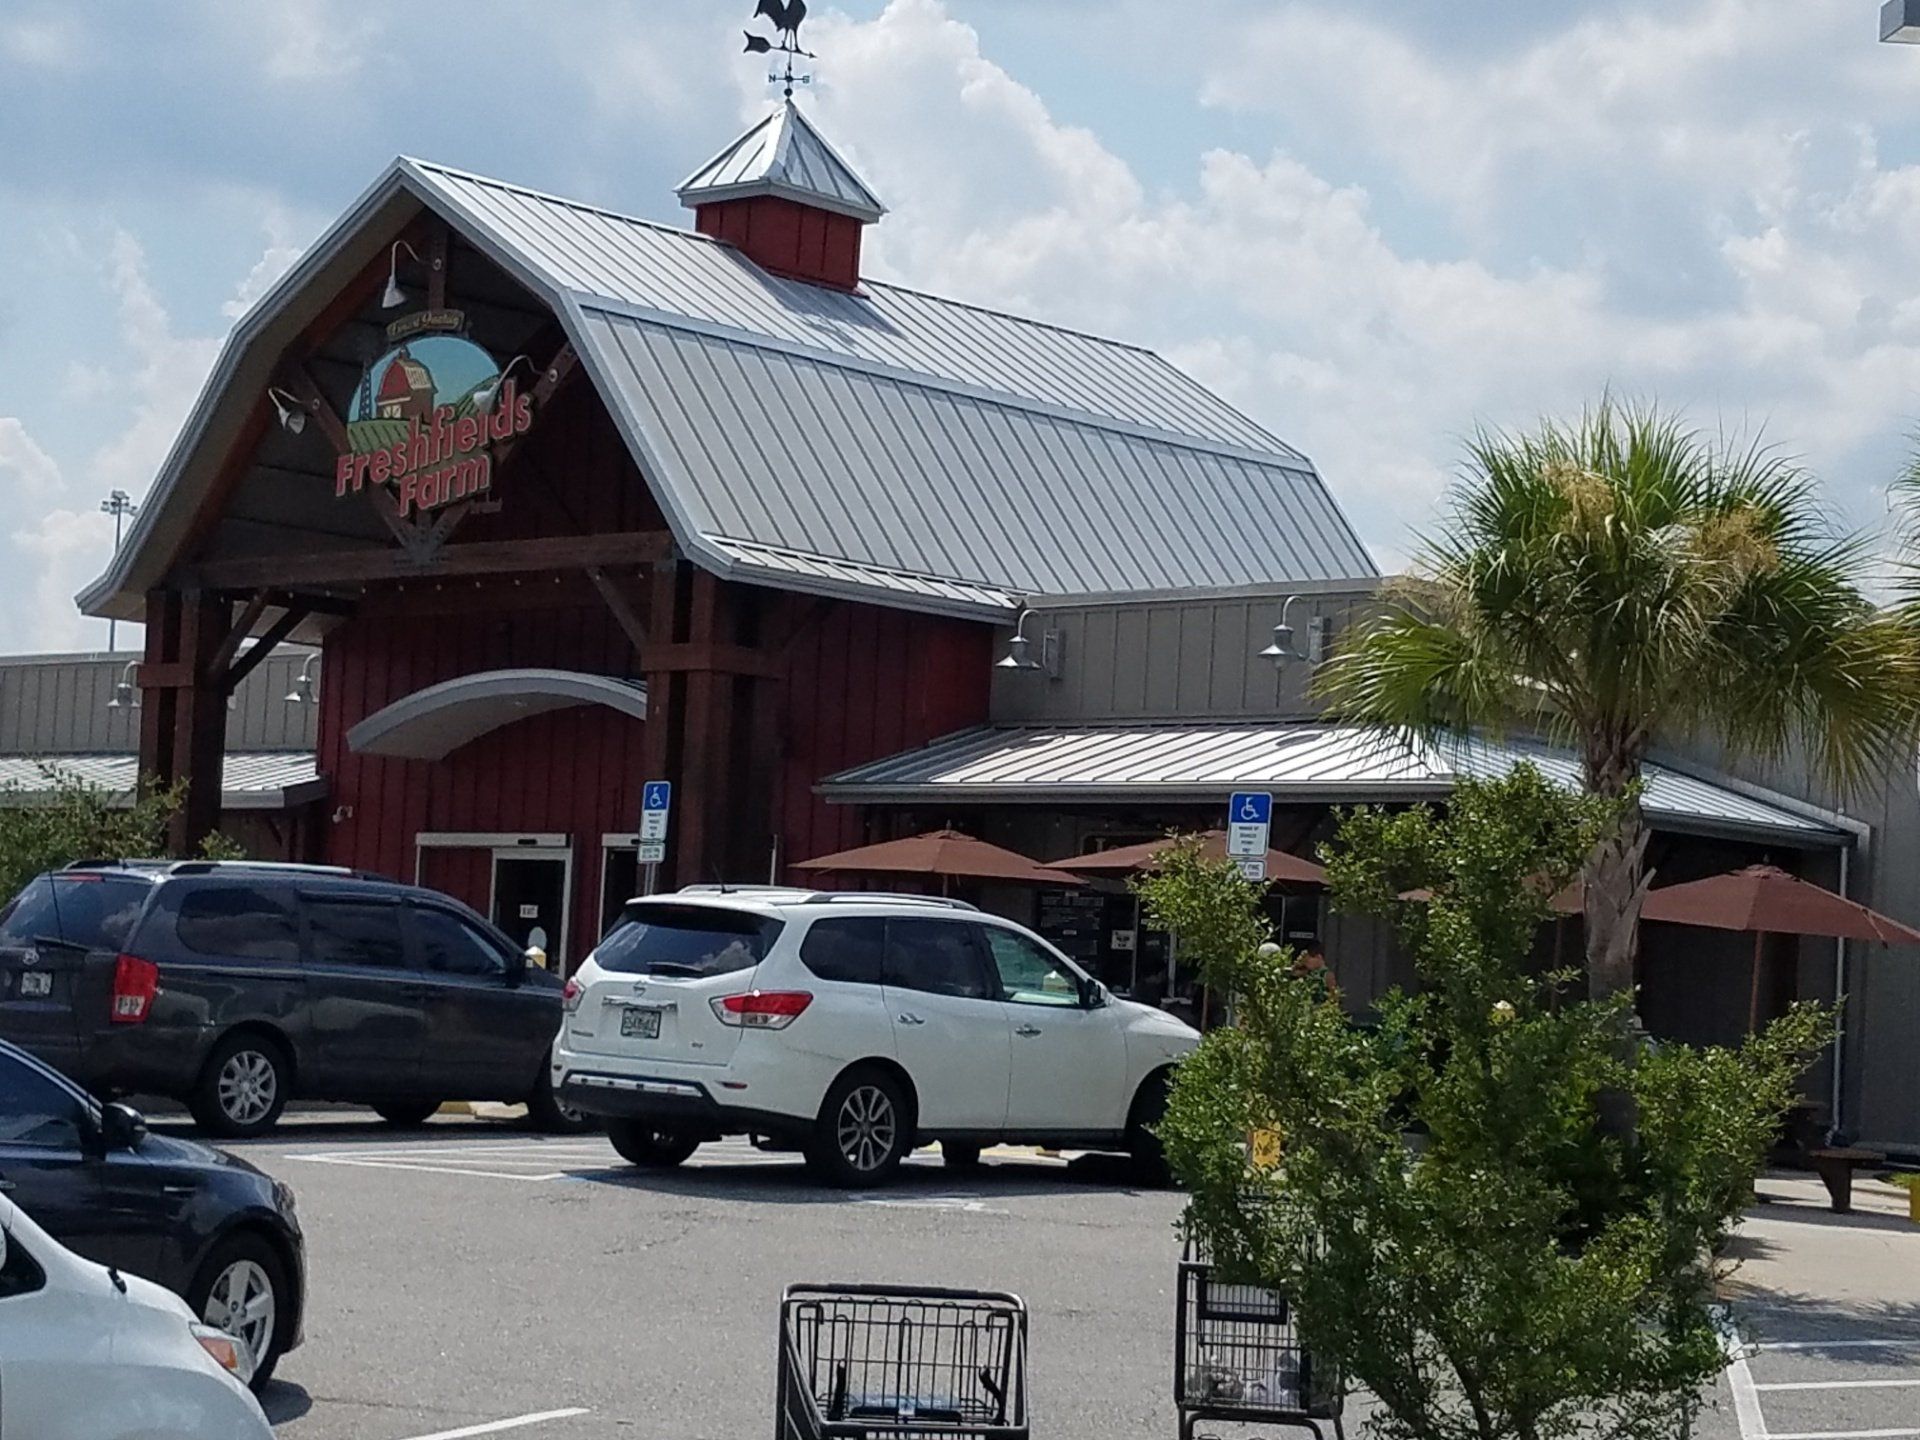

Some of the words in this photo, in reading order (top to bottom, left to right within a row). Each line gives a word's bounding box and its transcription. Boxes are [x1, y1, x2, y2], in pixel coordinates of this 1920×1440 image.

[768, 74, 776, 83] N
[335, 378, 532, 497] Freshfields
[399, 454, 490, 518] Farm
